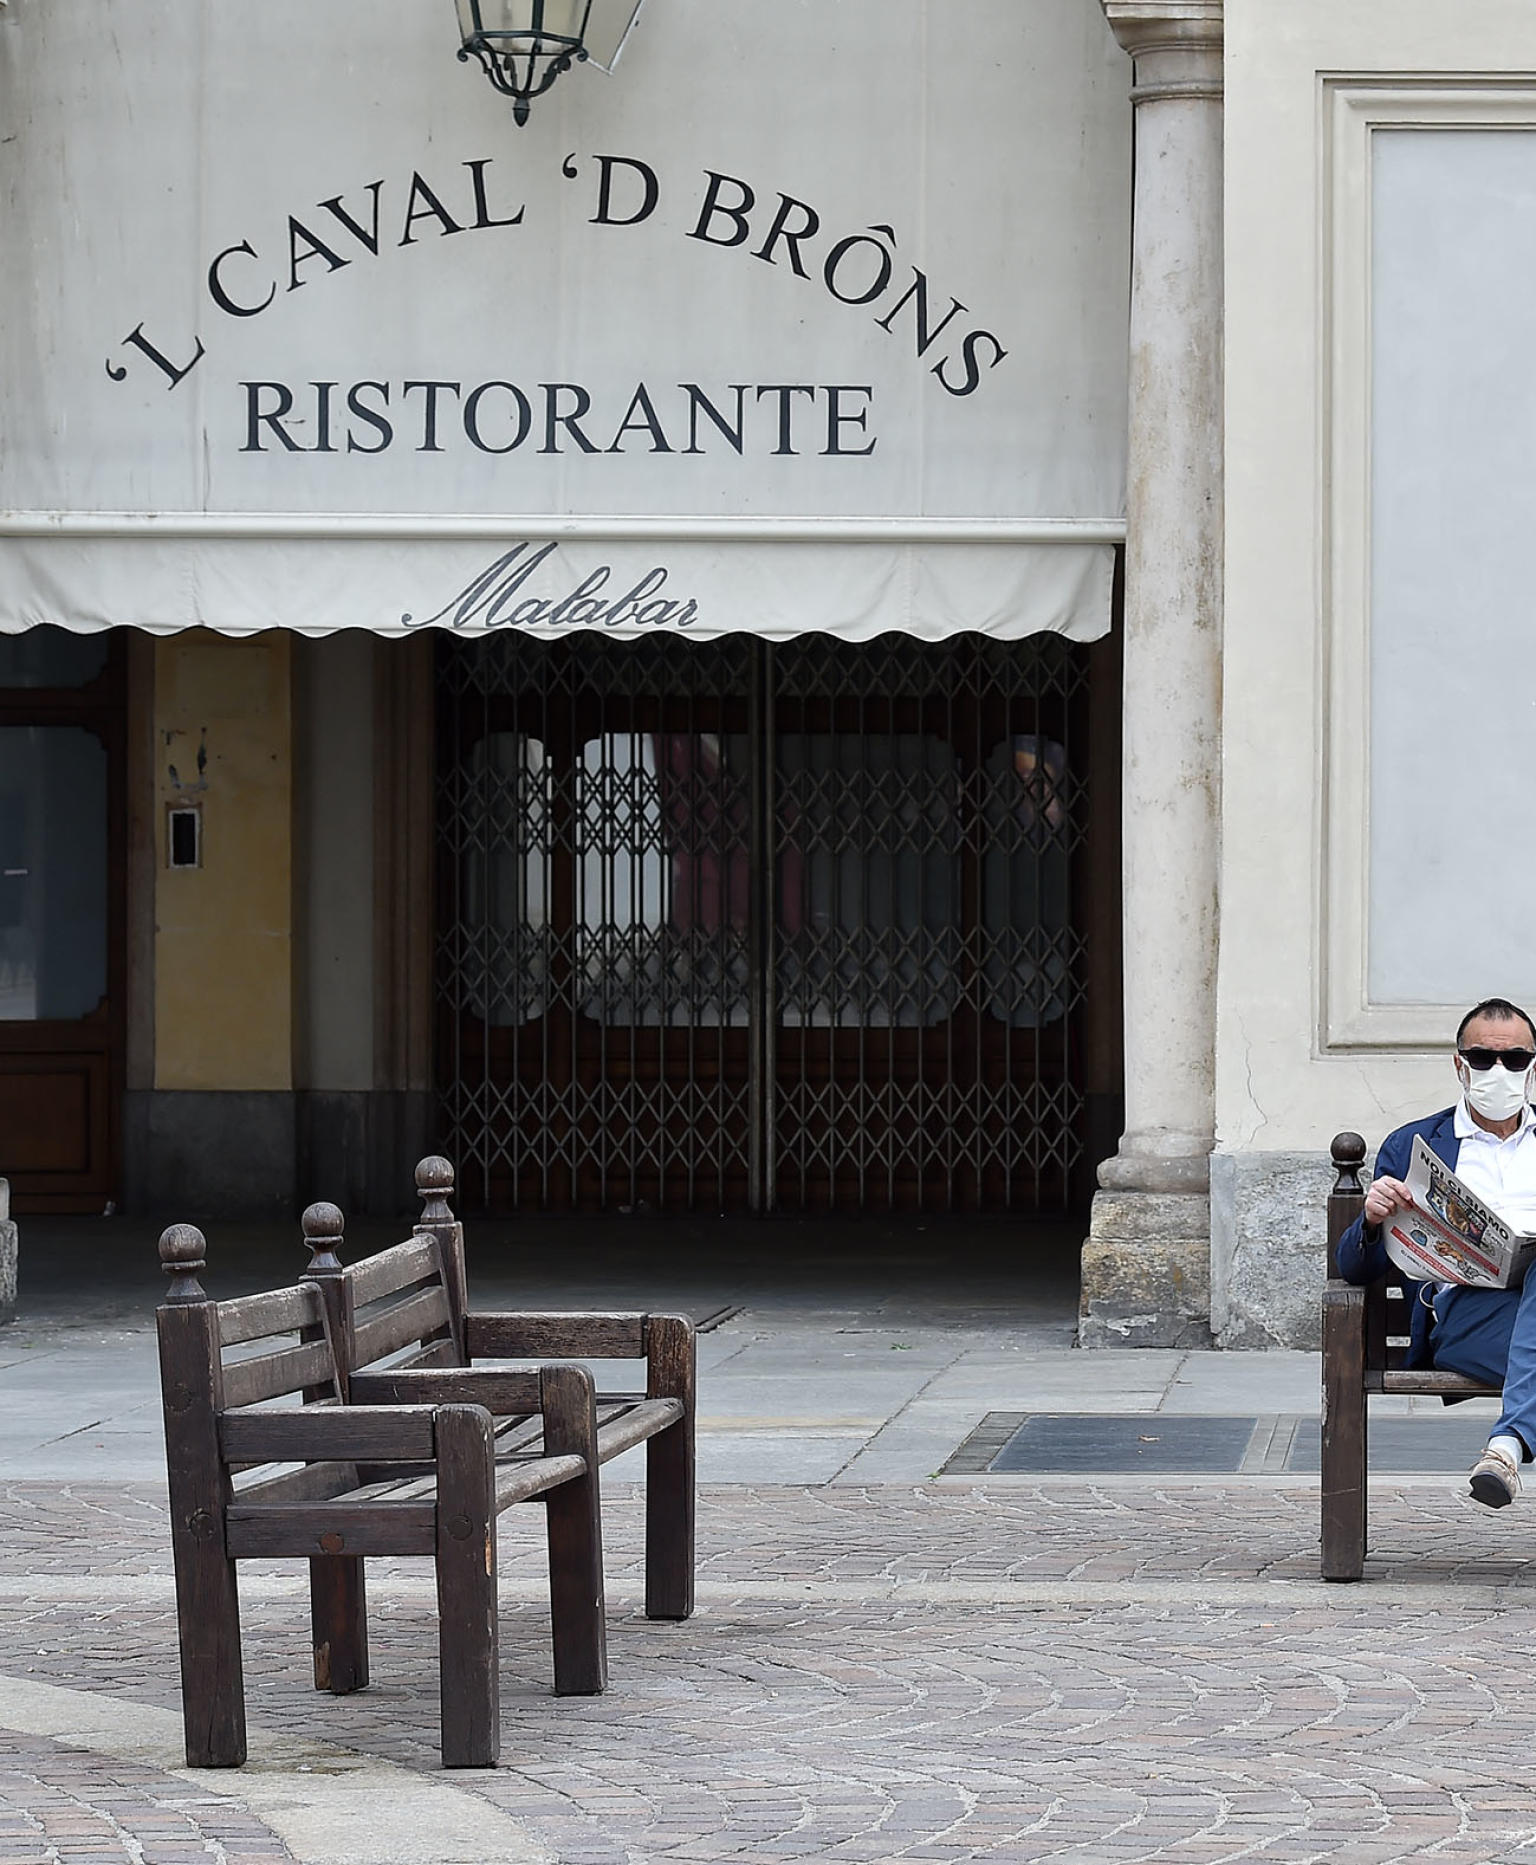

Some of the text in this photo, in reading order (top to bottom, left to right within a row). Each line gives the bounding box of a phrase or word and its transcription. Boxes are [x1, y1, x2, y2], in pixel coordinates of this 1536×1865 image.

[208, 158, 526, 318] CAVAL
[684, 169, 1009, 397] BRÔNS
[238, 381, 877, 456] RISTORANTE
[401, 541, 698, 628] Malabar
[1420, 1151, 1445, 1180] NOI
[1447, 1179, 1462, 1195] CI
[1465, 1194, 1510, 1241] SIAMO
